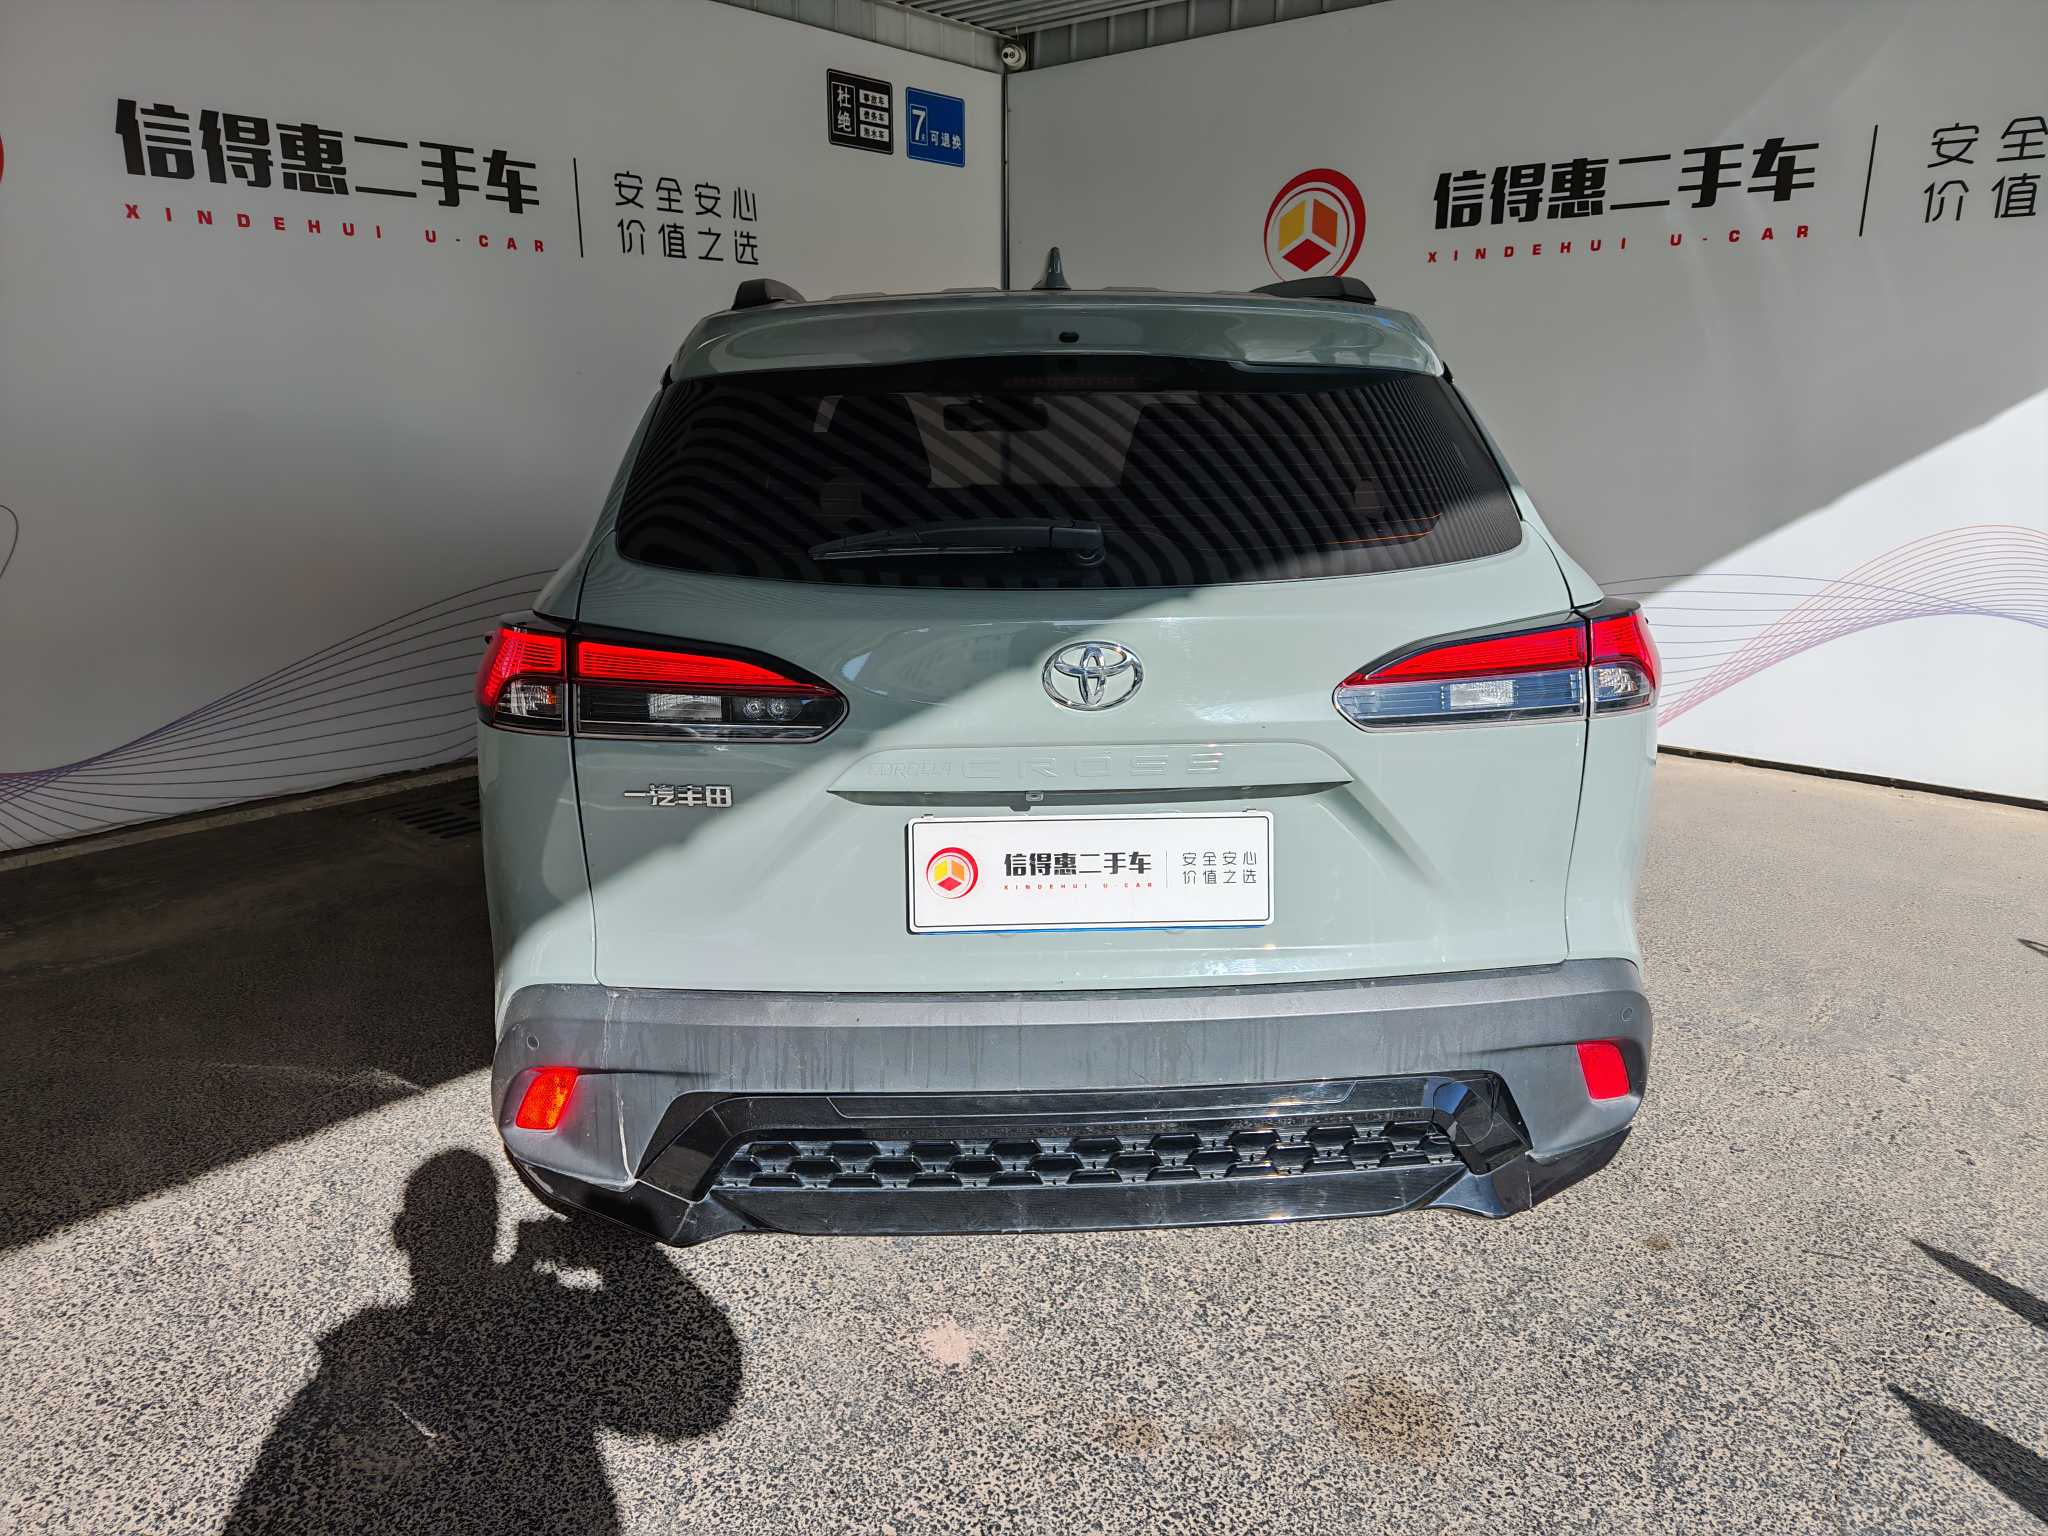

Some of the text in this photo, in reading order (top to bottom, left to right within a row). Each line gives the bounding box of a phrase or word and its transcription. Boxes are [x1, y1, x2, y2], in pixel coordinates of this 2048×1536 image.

[115, 98, 539, 213] 信得惠二手车
[1927, 116, 2048, 169] 安全
[614, 170, 757, 222] 安全安心
[1433, 137, 1820, 230] 信得惠二手车
[1923, 173, 2041, 224] 价值
[125, 203, 382, 238] XINDEHUI
[616, 217, 760, 266] 价值之选
[1427, 238, 1627, 264] XINDEHUI
[962, 752, 1224, 779] CROSS
[623, 784, 732, 807] 一汽丰田
[1004, 851, 1152, 877] 信得惠二手车
[1182, 851, 1257, 867] 安全安心
[1182, 869, 1257, 885] 价值之选
